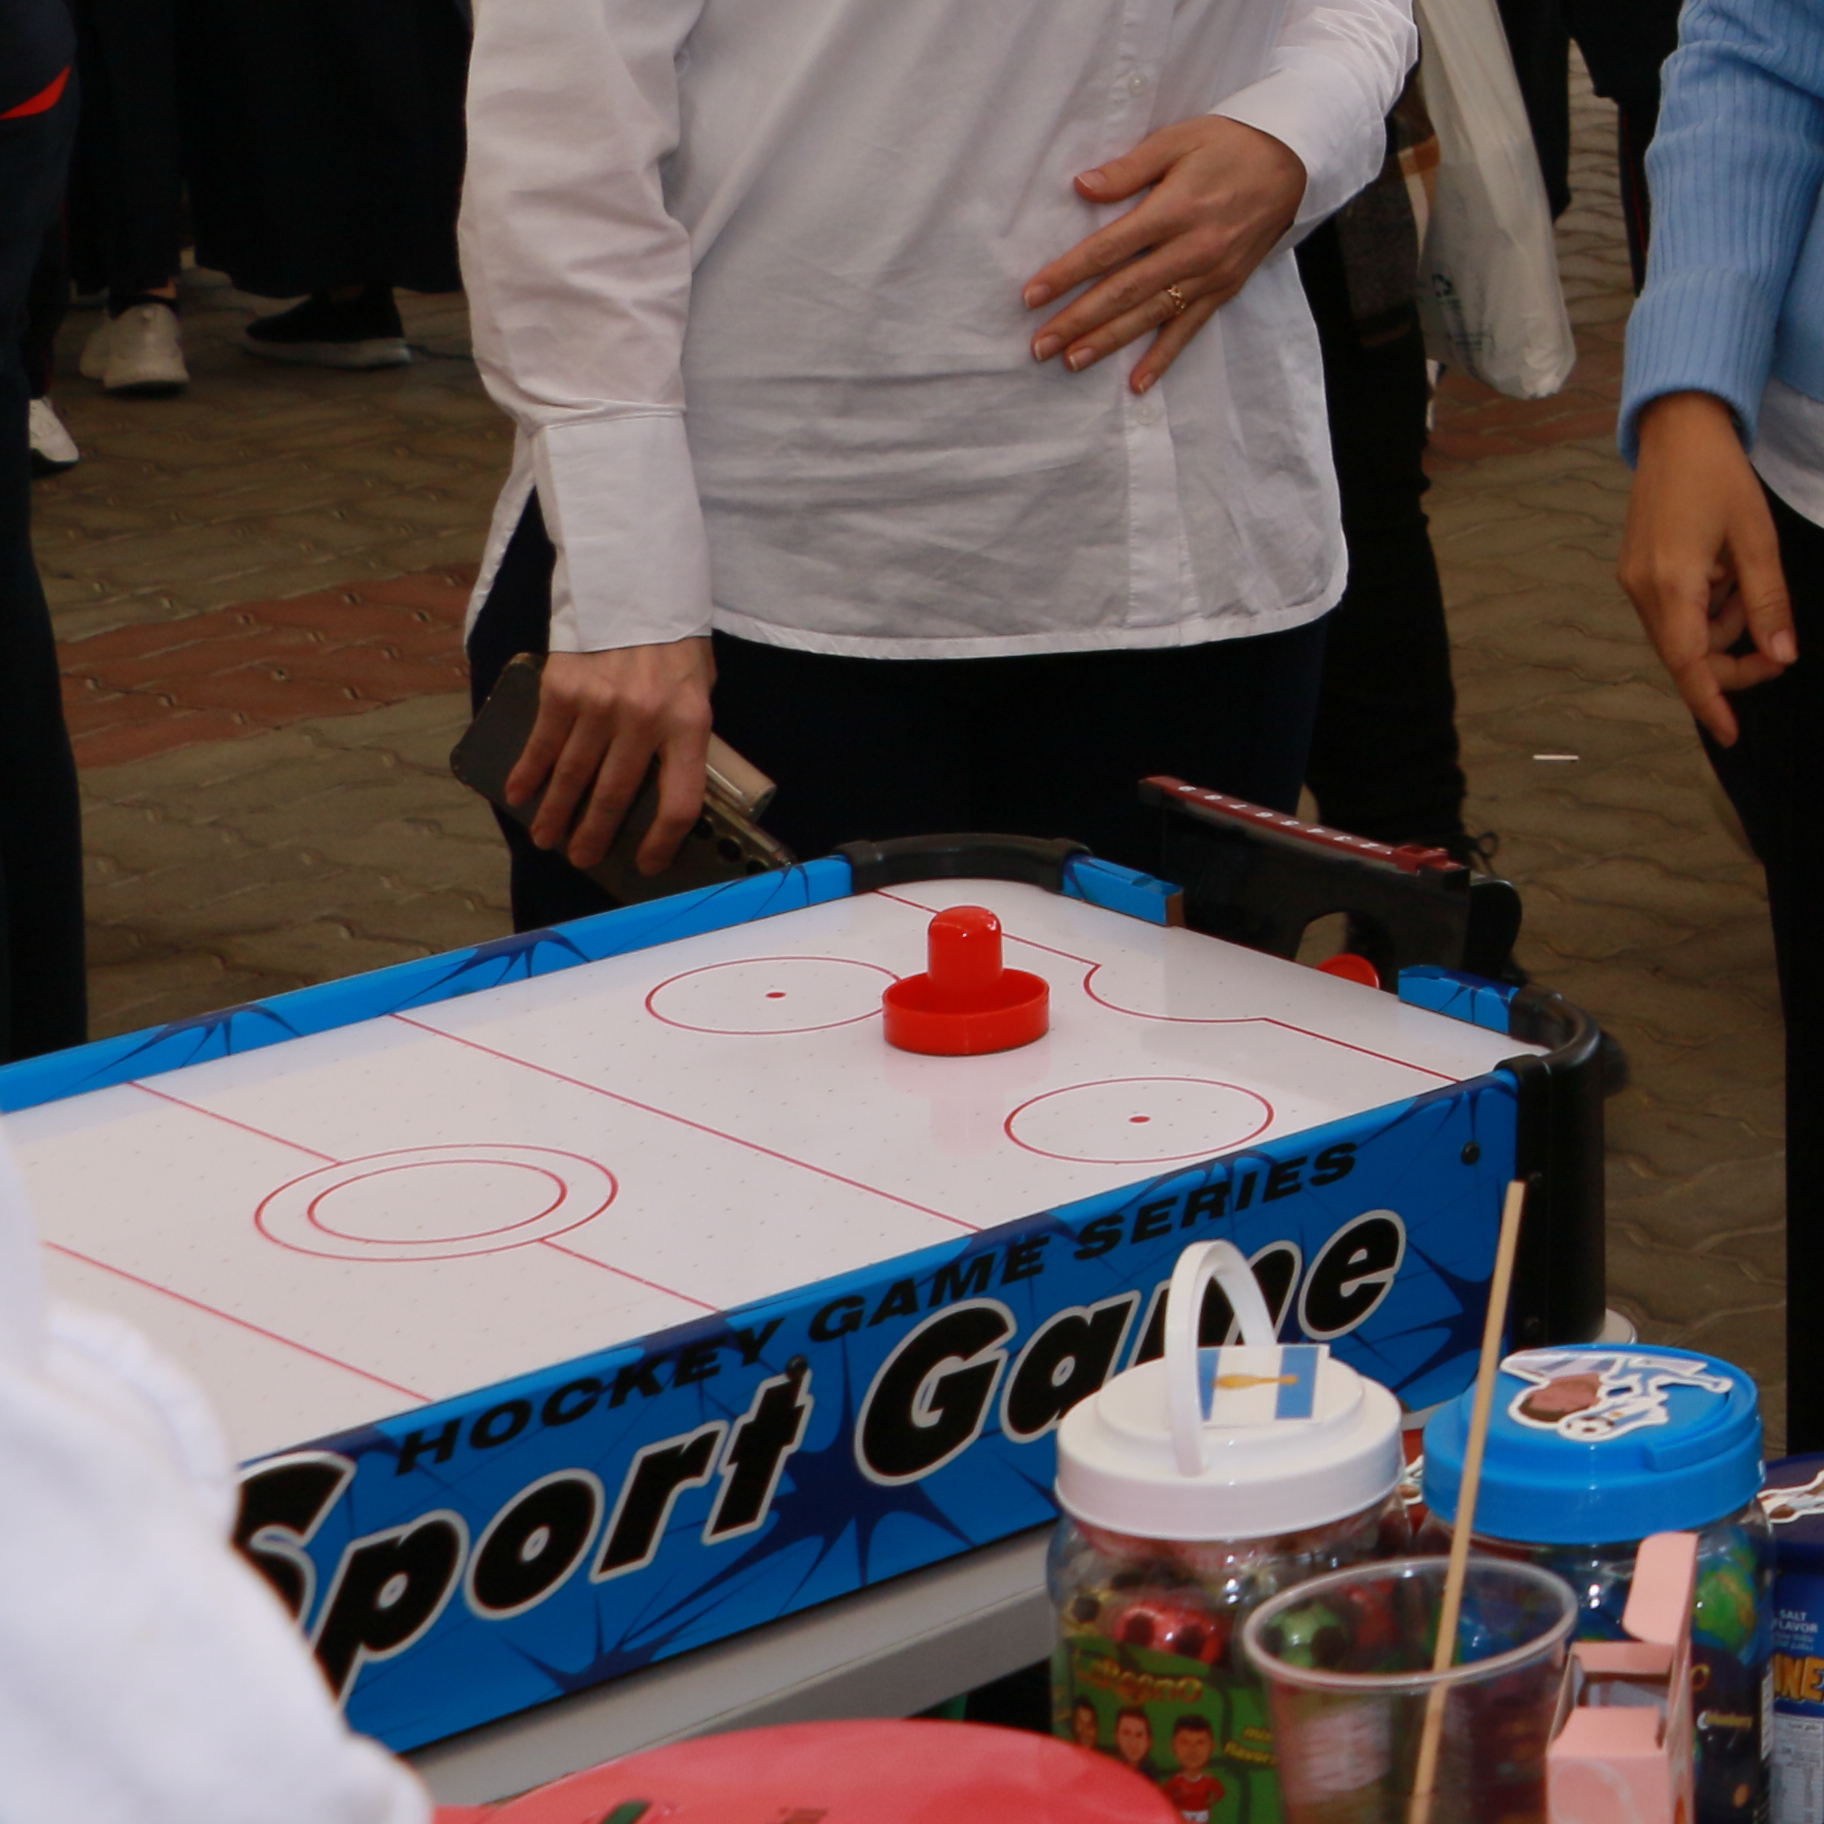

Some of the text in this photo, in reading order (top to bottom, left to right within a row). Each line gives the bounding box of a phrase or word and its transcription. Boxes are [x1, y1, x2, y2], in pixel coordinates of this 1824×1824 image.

[395, 1142, 1358, 1476] HOCKEY GAME SERIES
